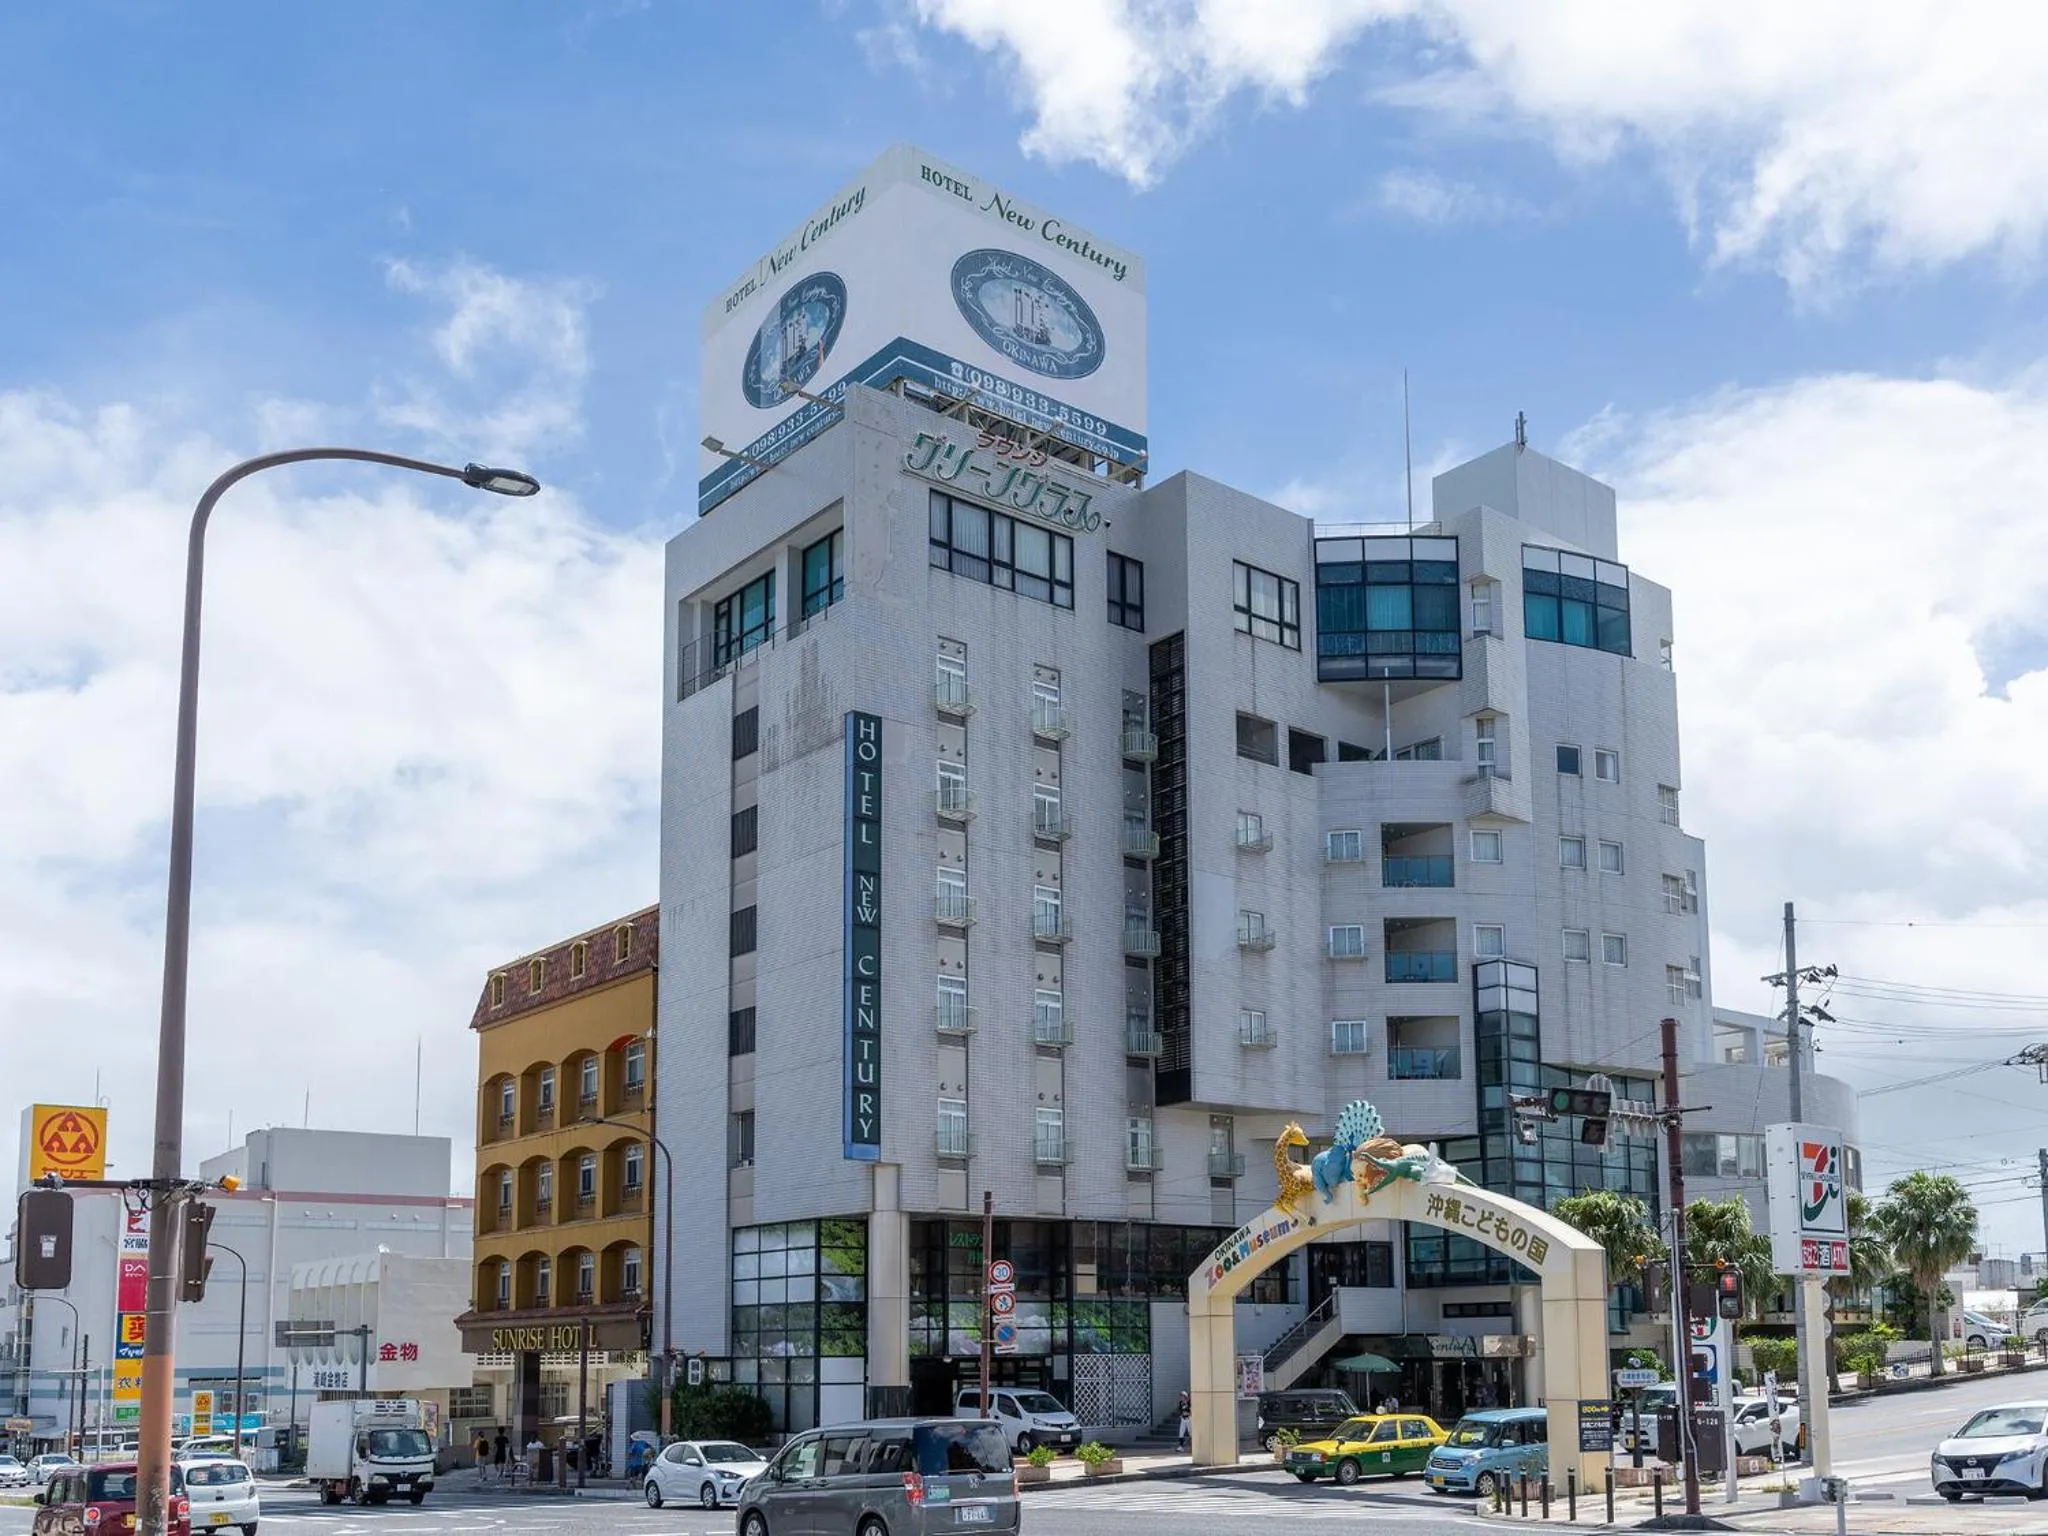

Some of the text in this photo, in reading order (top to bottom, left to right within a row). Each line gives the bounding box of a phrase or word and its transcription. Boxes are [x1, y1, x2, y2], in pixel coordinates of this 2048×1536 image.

[921, 165, 1128, 281] HOTEL New Century
[725, 279, 757, 314] HOTEL
[760, 244, 798, 287] New
[801, 185, 866, 251] Century
[1002, 340, 1058, 372] OKINAWA
[857, 719, 877, 1138] HOTEL NEW CENTURY
[1214, 1225, 1251, 1261] OKINAWA
[1426, 1193, 1549, 1265] 沖縄こどもの国
[995, 1267, 1008, 1278] 30
[379, 1342, 418, 1361] 金物
[492, 1324, 597, 1350] SUNRISE HOTL
